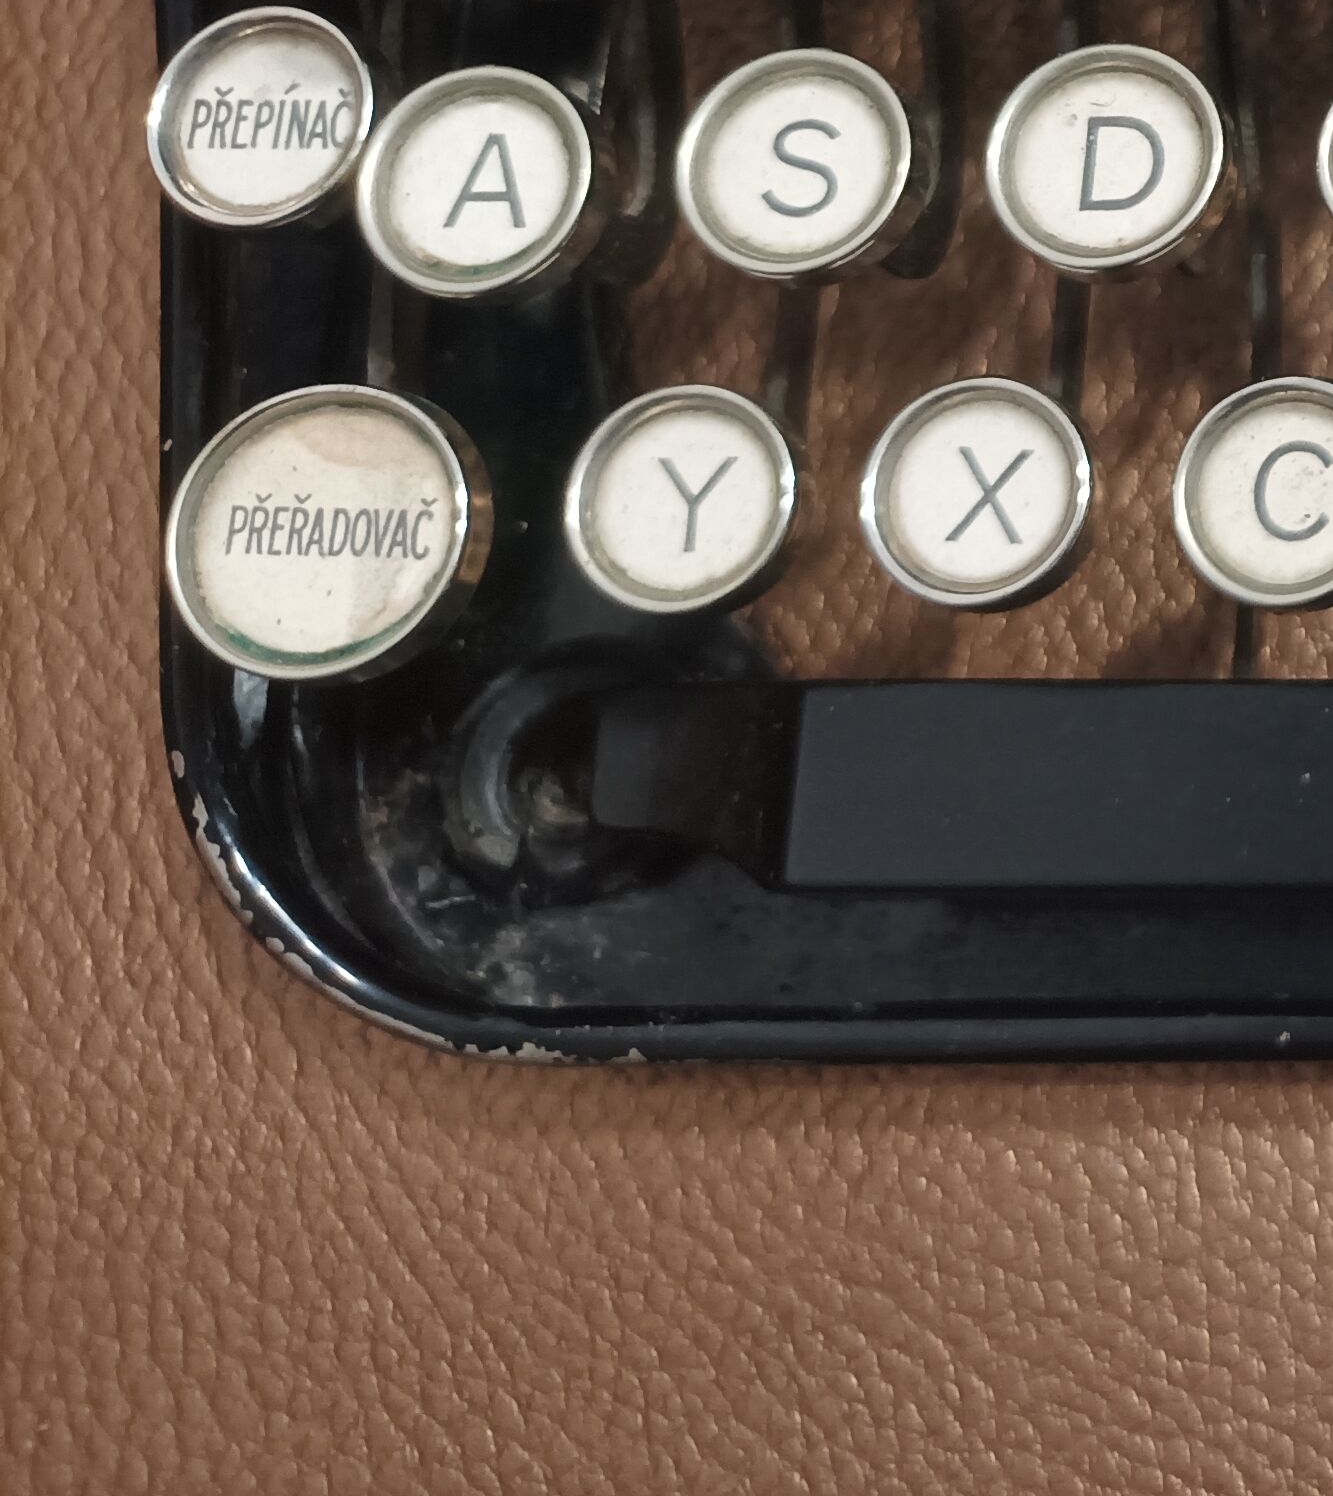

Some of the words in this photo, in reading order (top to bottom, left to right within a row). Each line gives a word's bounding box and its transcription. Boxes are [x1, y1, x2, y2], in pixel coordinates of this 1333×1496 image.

[188, 80, 357, 150] PŘEPÍNAČ
[1078, 115, 1165, 211] D
[443, 133, 527, 229] A
[761, 118, 842, 218] S
[225, 492, 439, 561] PŘEŘADOVAČ
[658, 456, 738, 552] Y
[944, 445, 1035, 545] X
